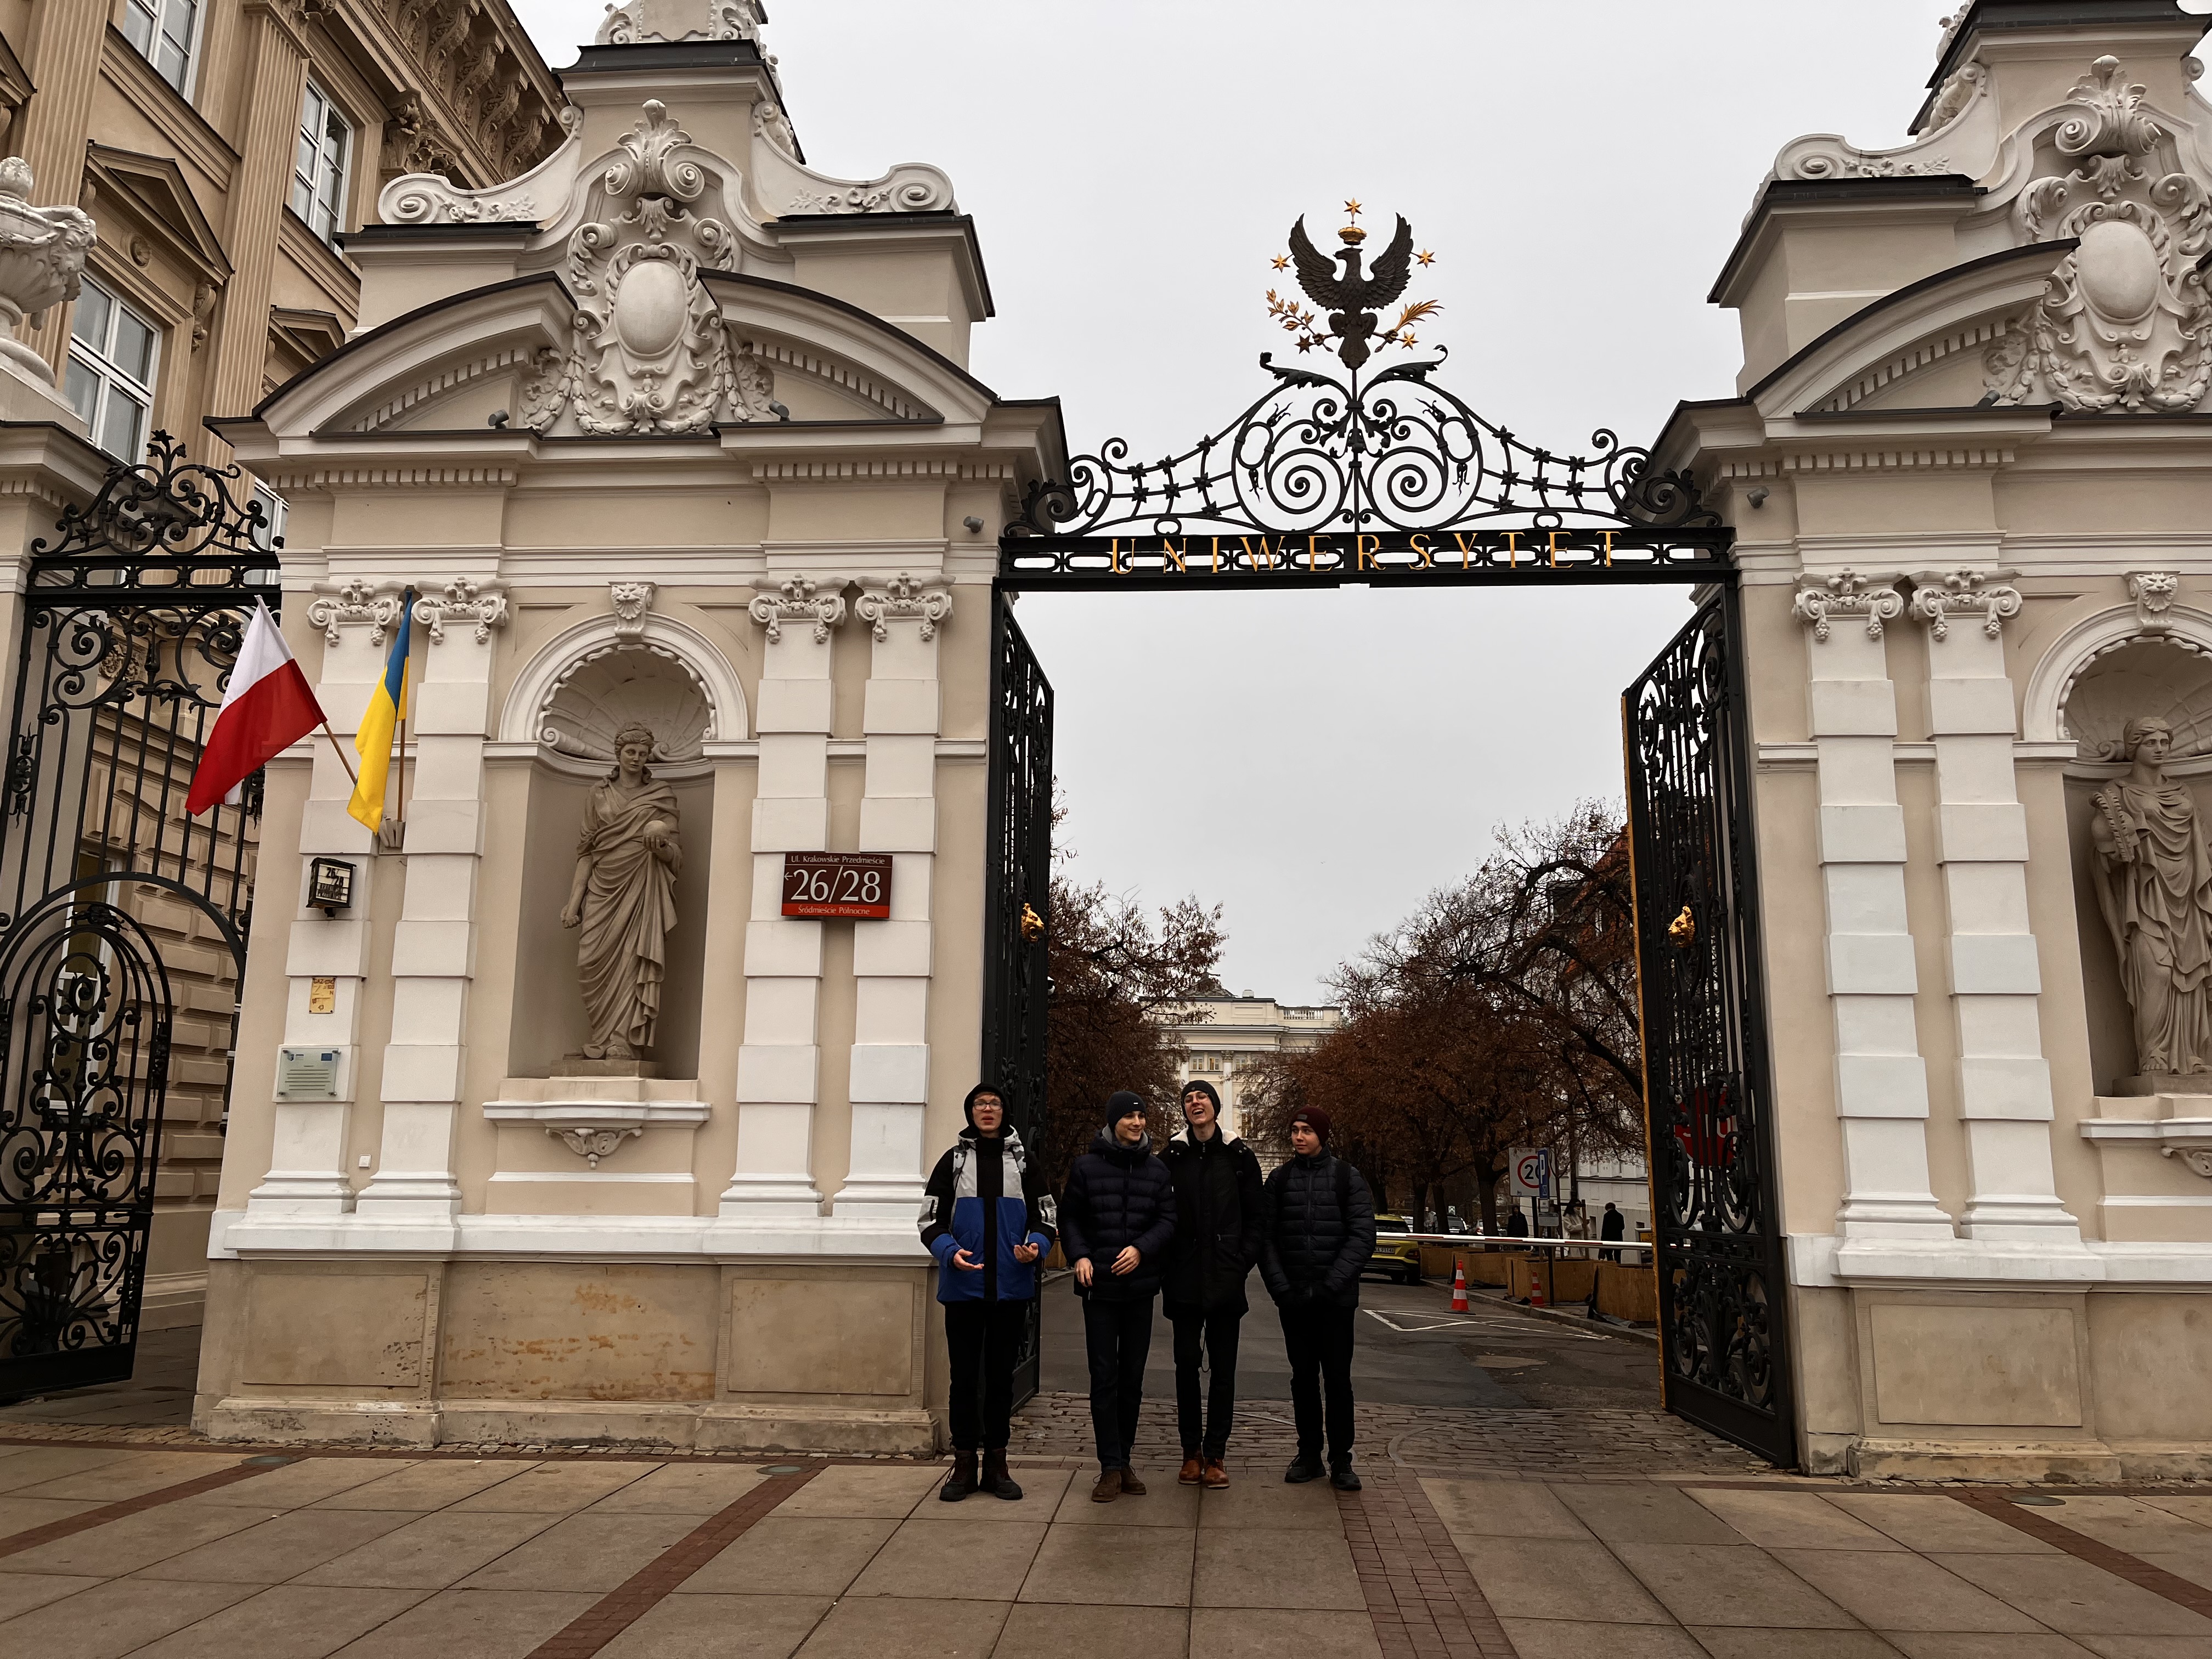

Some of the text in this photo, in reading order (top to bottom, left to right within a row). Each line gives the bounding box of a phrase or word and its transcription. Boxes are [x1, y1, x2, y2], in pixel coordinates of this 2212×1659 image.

[1112, 531, 1622, 574] UNIWERSYTET
[842, 856, 885, 865] Przedmieście
[791, 866, 881, 903] 26/28
[798, 904, 837, 914] Śródmieście
[1539, 1154, 1545, 1184] P
